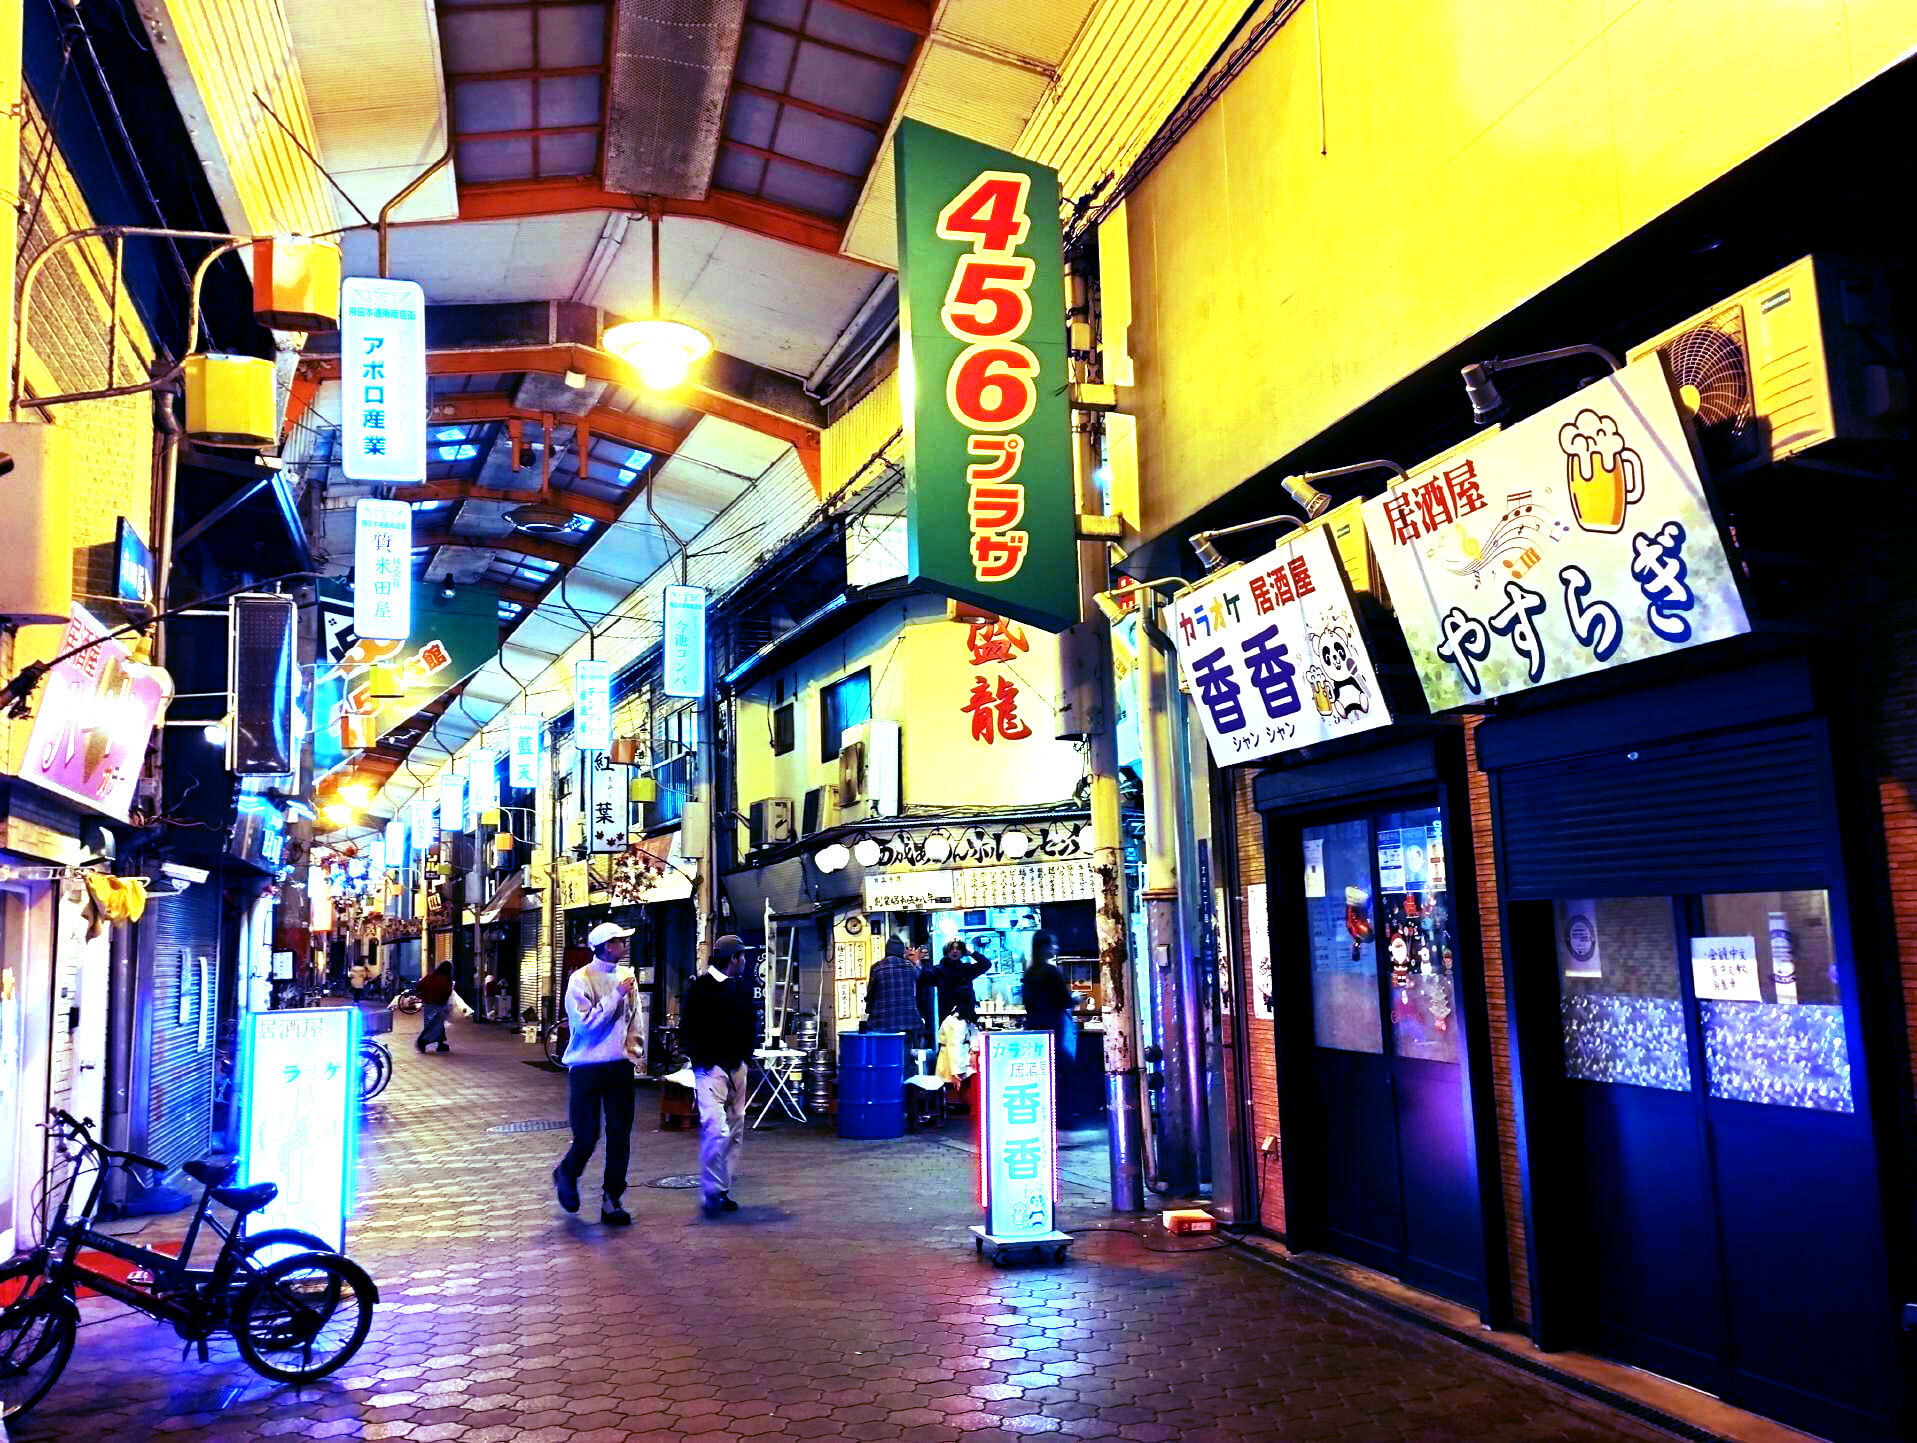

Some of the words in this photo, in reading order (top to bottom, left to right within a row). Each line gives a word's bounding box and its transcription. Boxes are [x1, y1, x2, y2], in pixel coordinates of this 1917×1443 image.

[362, 336, 386, 456] アポロ産業
[1382, 459, 1489, 545] 居酒屋
[1179, 592, 1242, 647] カラオケ
[1248, 556, 1316, 616] 居酒屋
[1437, 520, 1695, 695] やすらぎ
[1191, 624, 1302, 734] 香香
[594, 752, 615, 824] 紅葉
[992, 1042, 1045, 1058] カラオケ
[1010, 1061, 1048, 1078] 居酒屋
[1002, 1082, 1042, 1180] 香香
